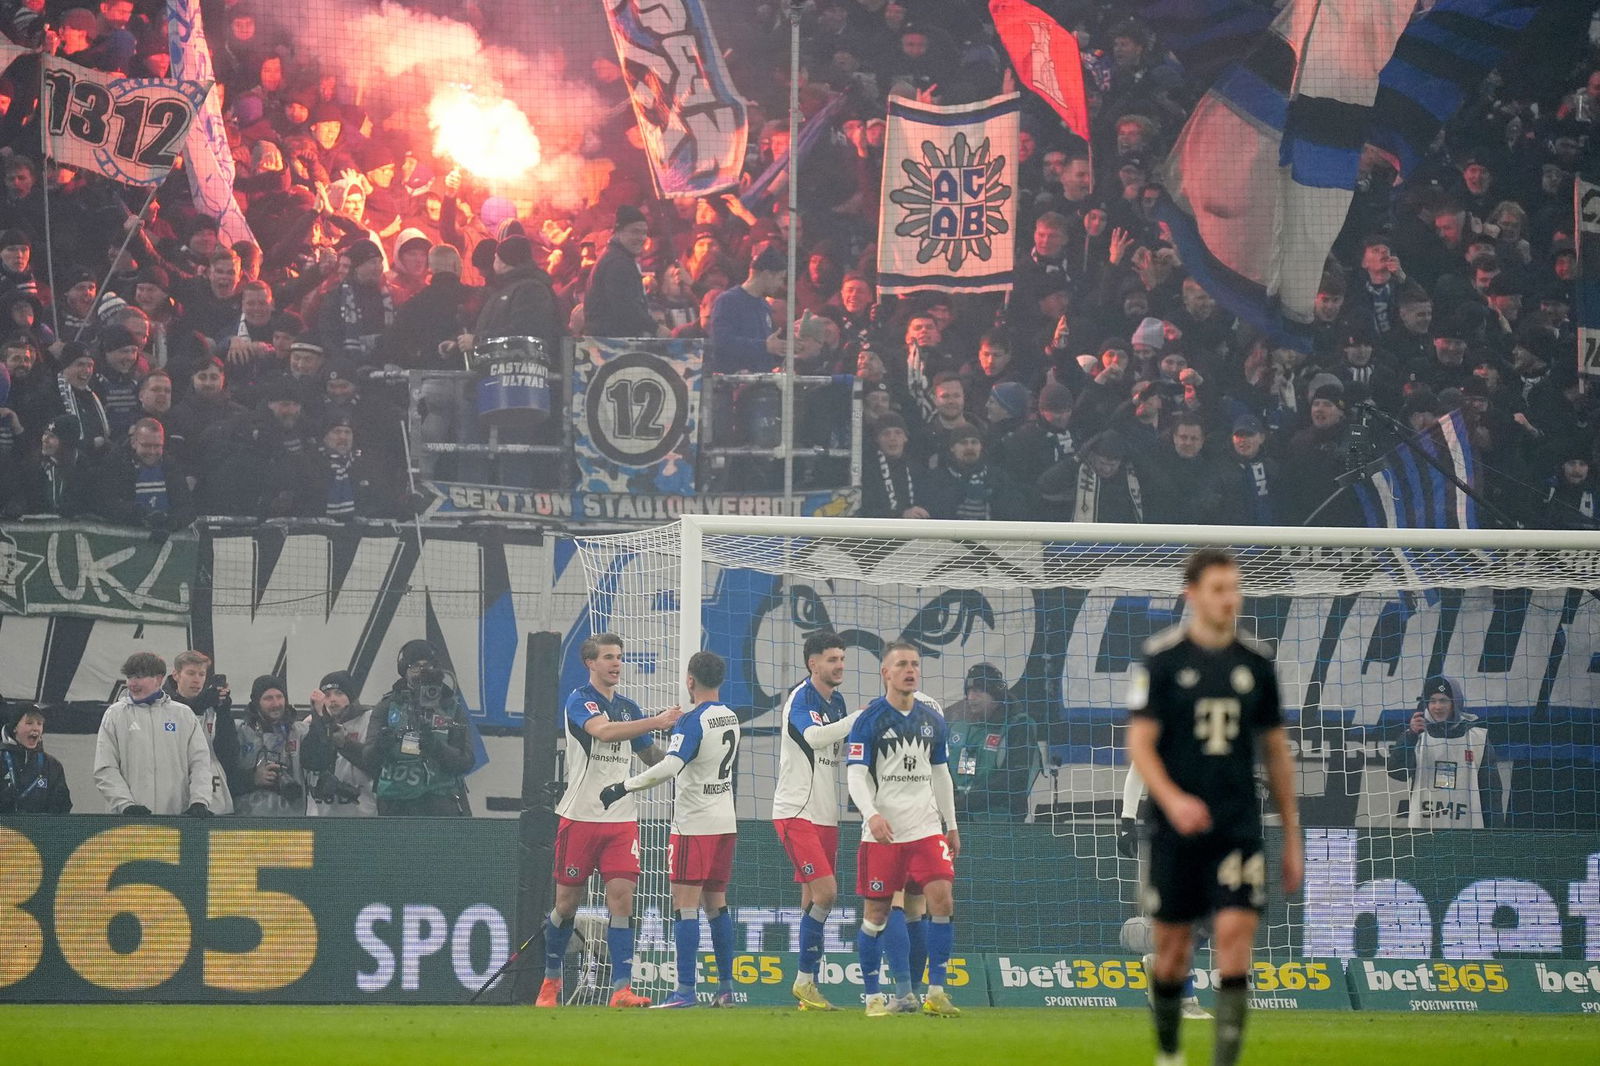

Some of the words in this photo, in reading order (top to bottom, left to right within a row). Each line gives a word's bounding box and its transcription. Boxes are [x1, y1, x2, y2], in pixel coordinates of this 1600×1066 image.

[45, 69, 192, 168] 1312
[606, 378, 666, 440] 12
[450, 486, 572, 516] SEKTION
[584, 494, 806, 519] STADIONVERBOT
[718, 729, 736, 780] 2
[1421, 800, 1467, 820] SMF
[1217, 851, 1266, 890] 44
[999, 957, 1148, 989] bet365
[1363, 961, 1510, 993] bet365
[1044, 996, 1117, 1007] SPORTWETTEN
[1411, 1000, 1478, 1011] SPORTWETTEN
